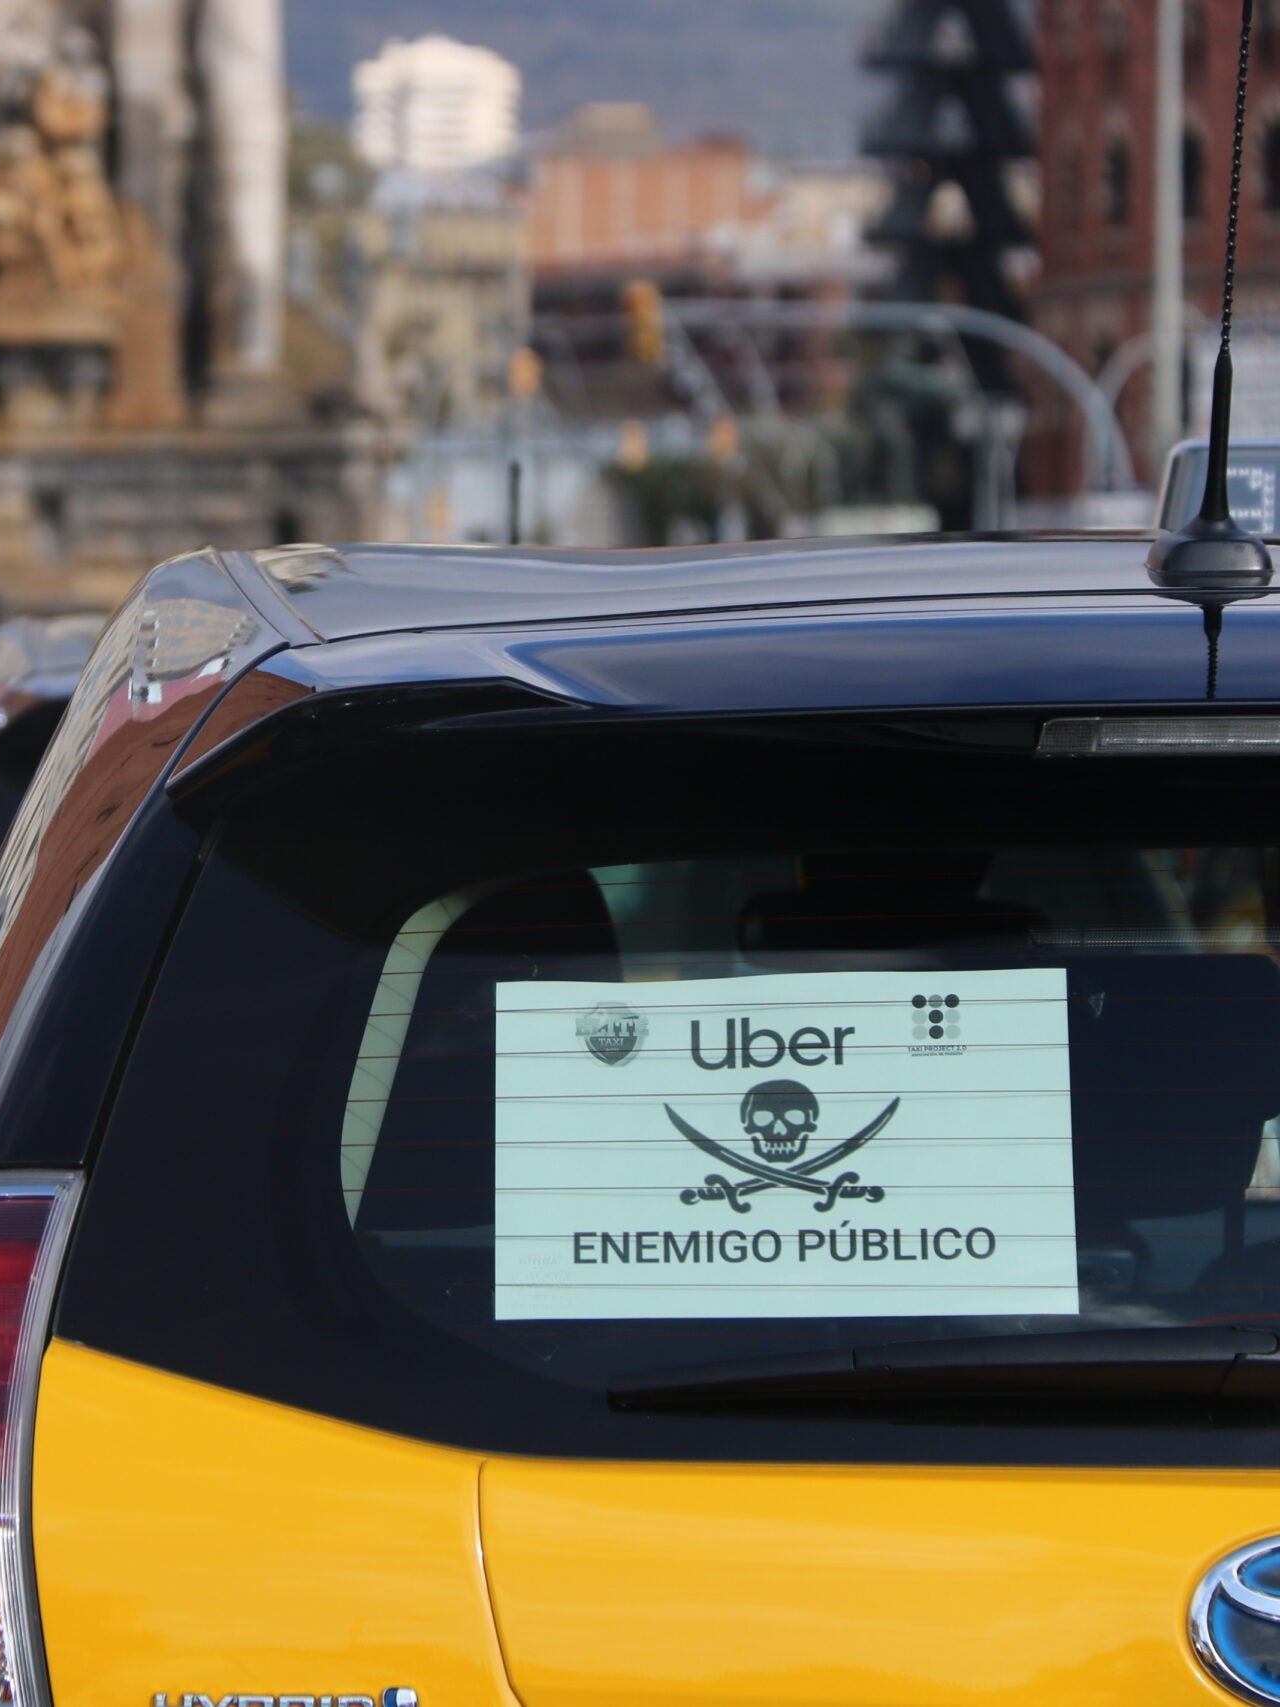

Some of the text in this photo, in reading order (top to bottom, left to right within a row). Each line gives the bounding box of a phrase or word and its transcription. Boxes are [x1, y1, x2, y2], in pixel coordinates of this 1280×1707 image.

[598, 1037, 624, 1046] TAXI
[689, 1016, 856, 1071] Uber
[572, 1219, 997, 1264] ENEMIGO PÚBLICO
